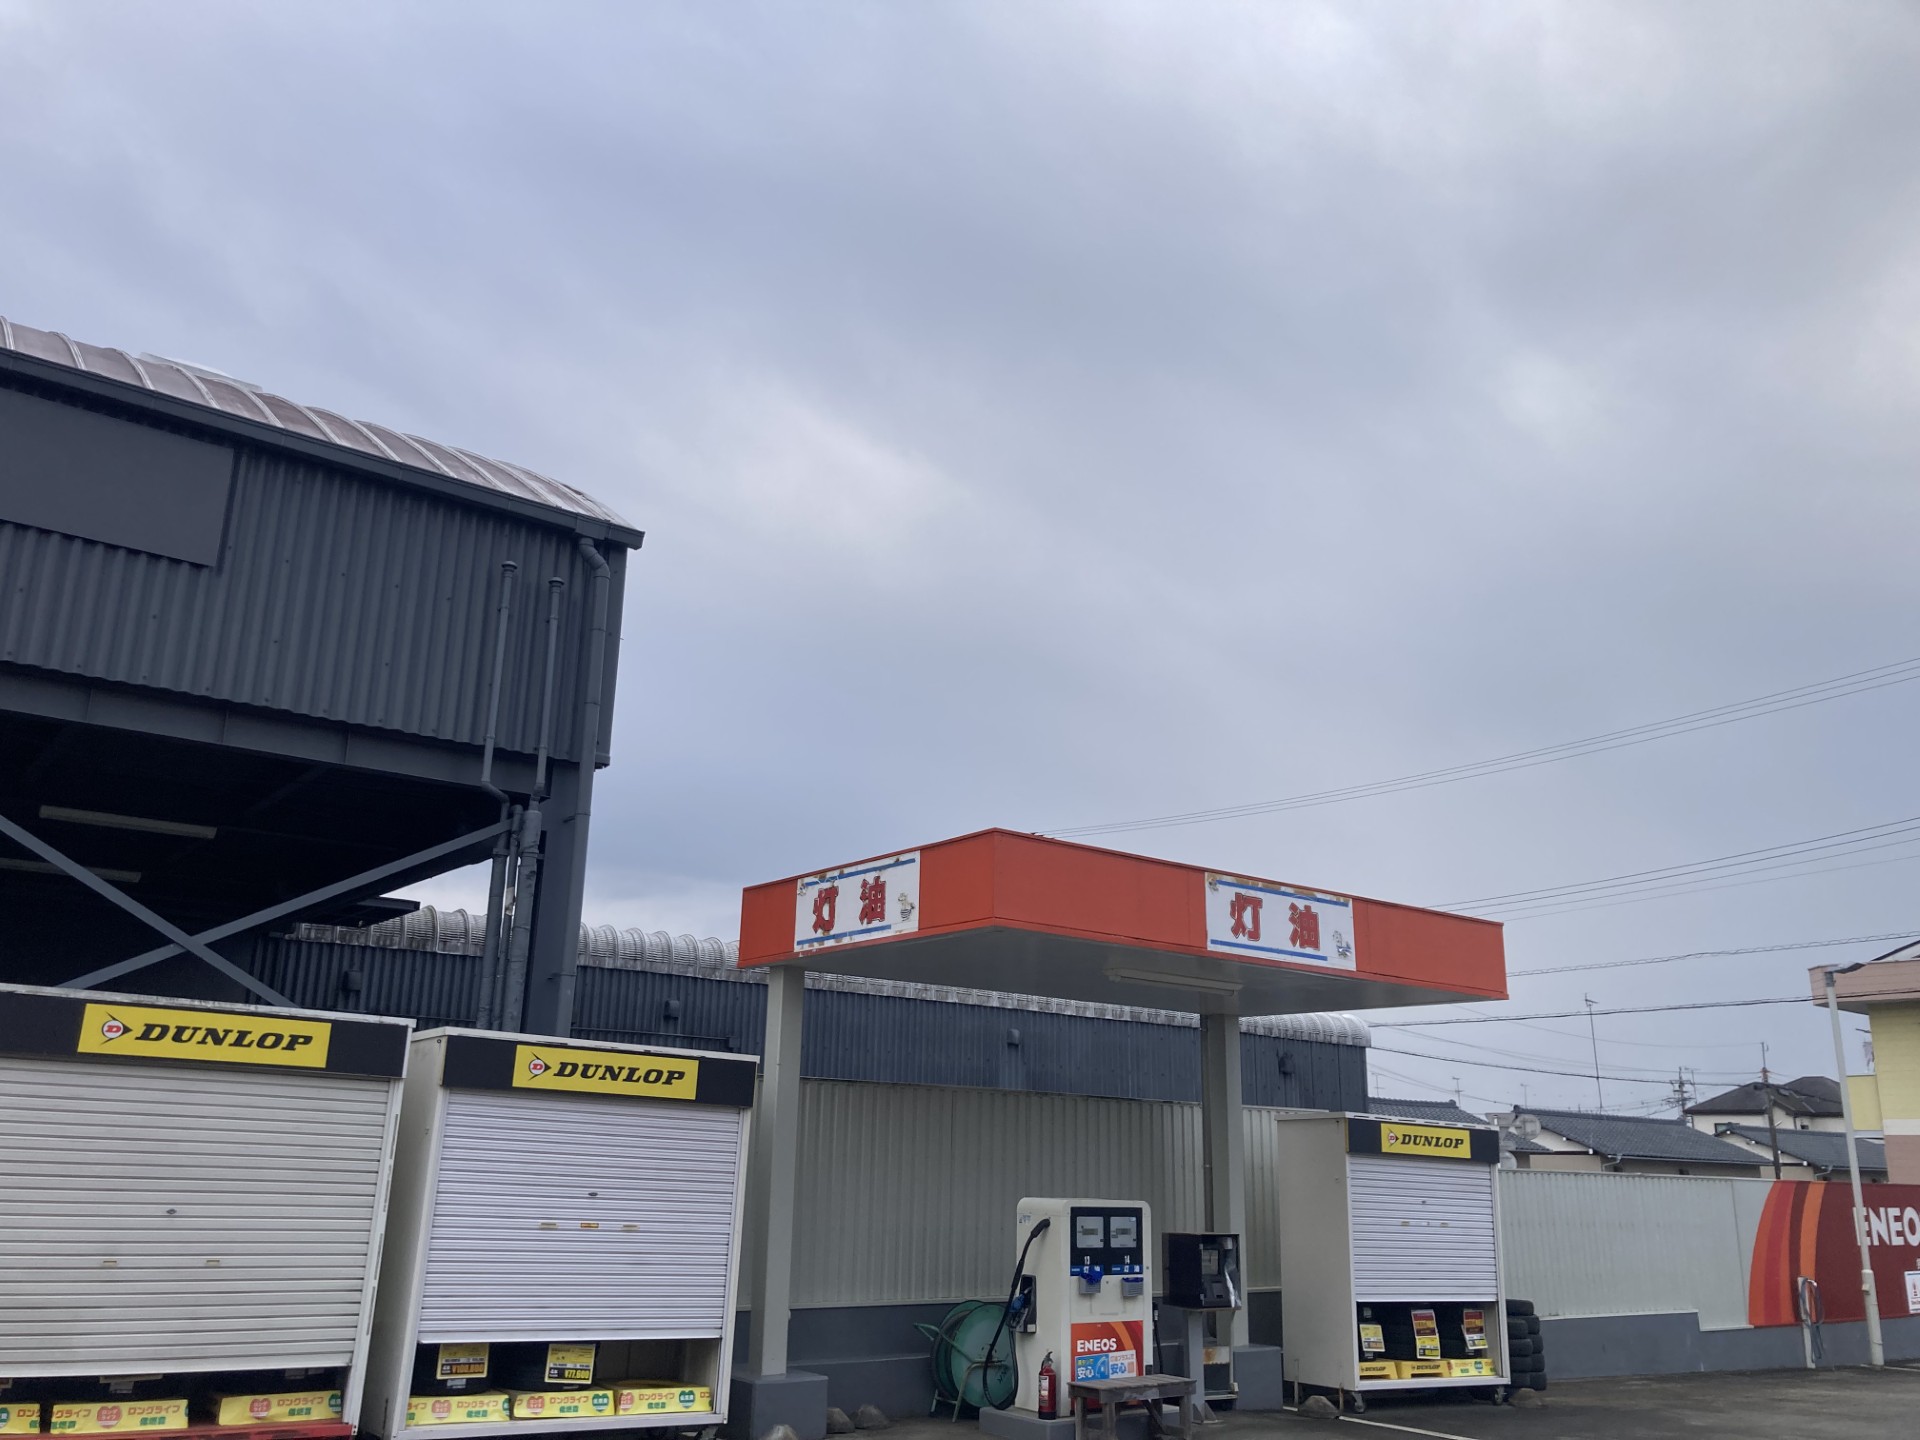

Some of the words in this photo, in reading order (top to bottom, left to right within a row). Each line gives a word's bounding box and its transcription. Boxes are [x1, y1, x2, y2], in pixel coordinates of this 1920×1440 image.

[812, 875, 887, 934] 灯油
[1230, 892, 1320, 951] 灯油
[134, 1023, 313, 1051] DUNLOP
[553, 1061, 686, 1085] DUNLOP
[1400, 1133, 1464, 1149] DUNLOP
[1076, 1338, 1117, 1352] ENEOS
